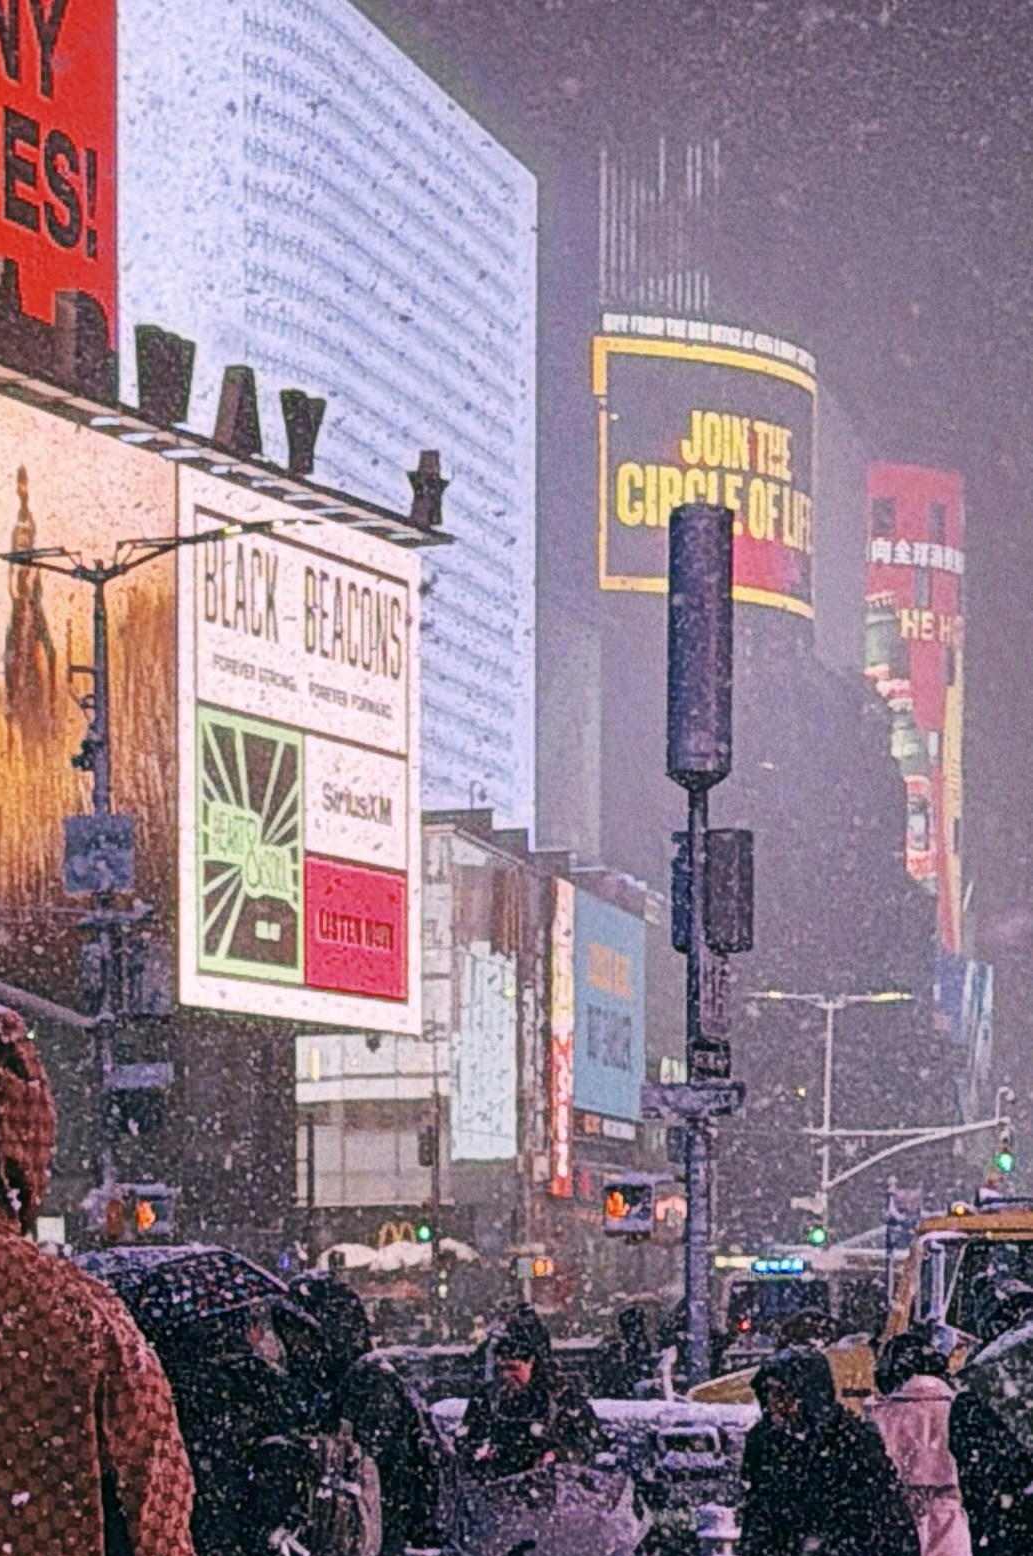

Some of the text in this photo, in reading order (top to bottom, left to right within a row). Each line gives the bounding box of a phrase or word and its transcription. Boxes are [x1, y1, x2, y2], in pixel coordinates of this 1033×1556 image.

[681, 409, 792, 482] JOIN THE
[748, 478, 780, 541] OF
[204, 535, 279, 645] BLACK
[896, 608, 935, 642] HE
